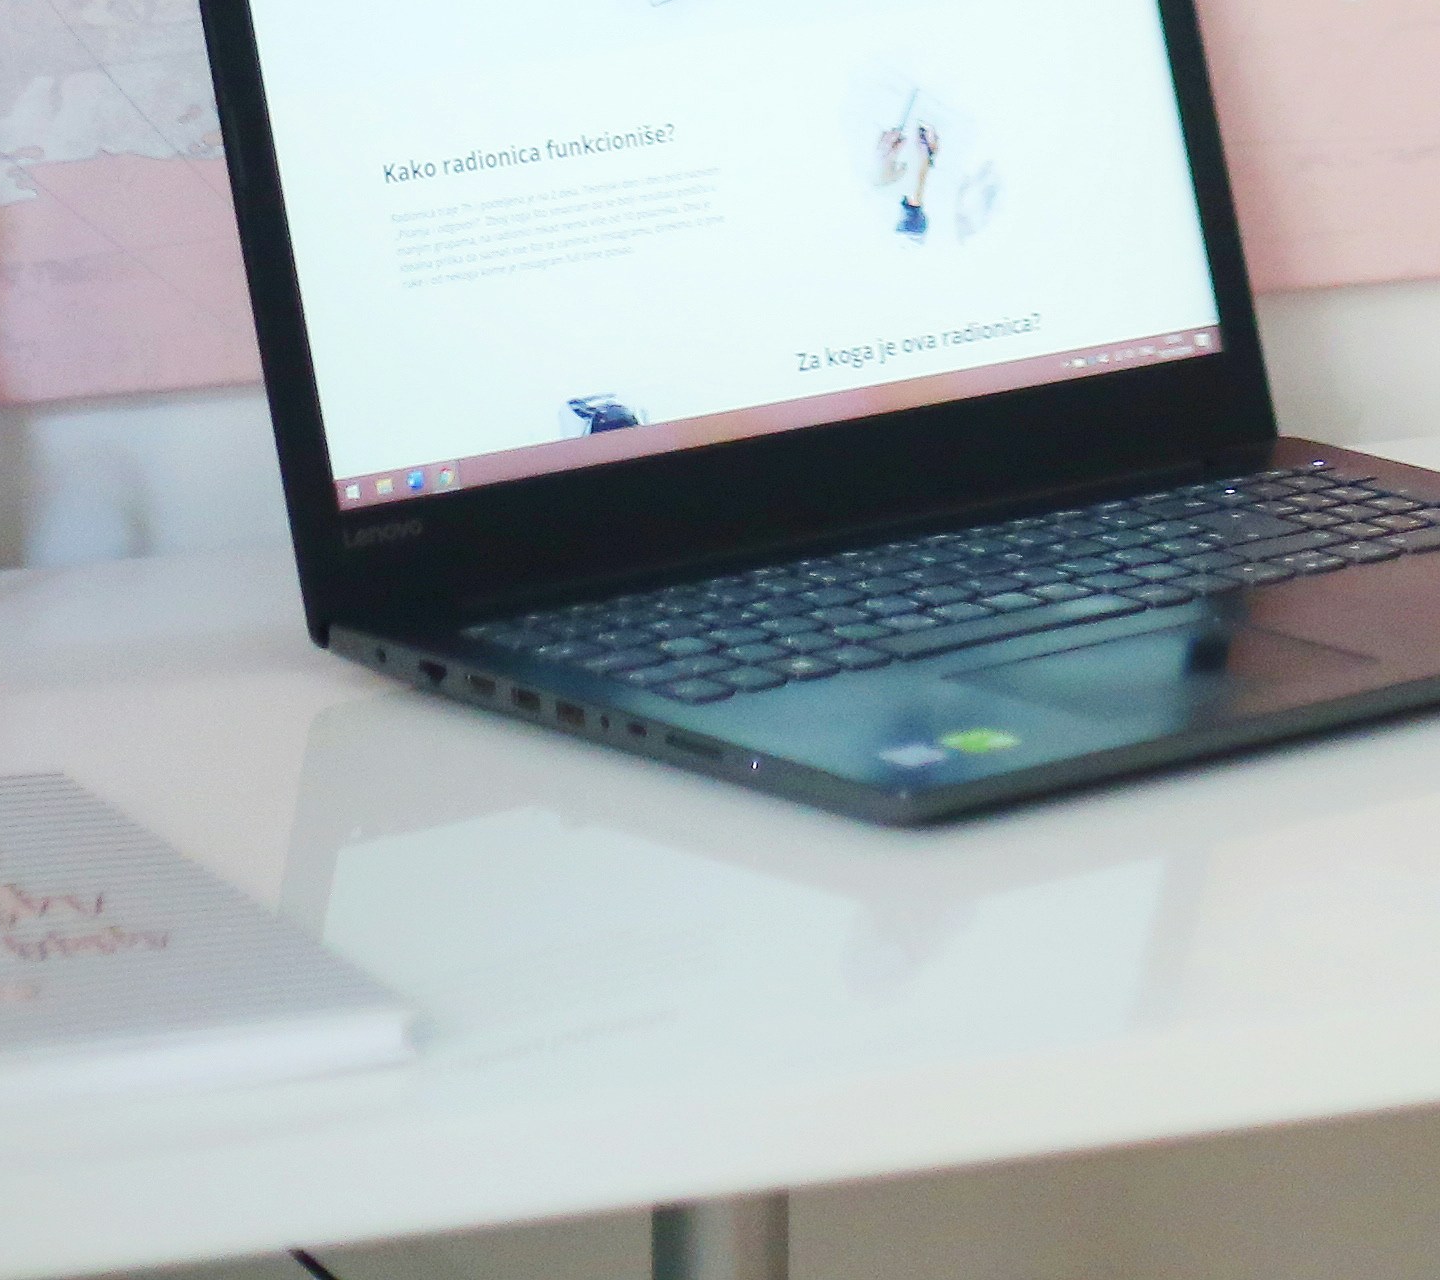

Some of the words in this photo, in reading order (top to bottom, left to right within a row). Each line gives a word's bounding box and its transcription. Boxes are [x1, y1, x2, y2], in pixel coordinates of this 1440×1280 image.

[383, 160, 436, 184] Kako
[443, 145, 541, 175] radionica
[545, 123, 675, 160] funkcioniše?
[796, 353, 820, 372] Za
[825, 344, 874, 369] koga
[877, 338, 896, 365] je
[902, 335, 936, 354] ova
[942, 313, 1041, 346] radionica?
